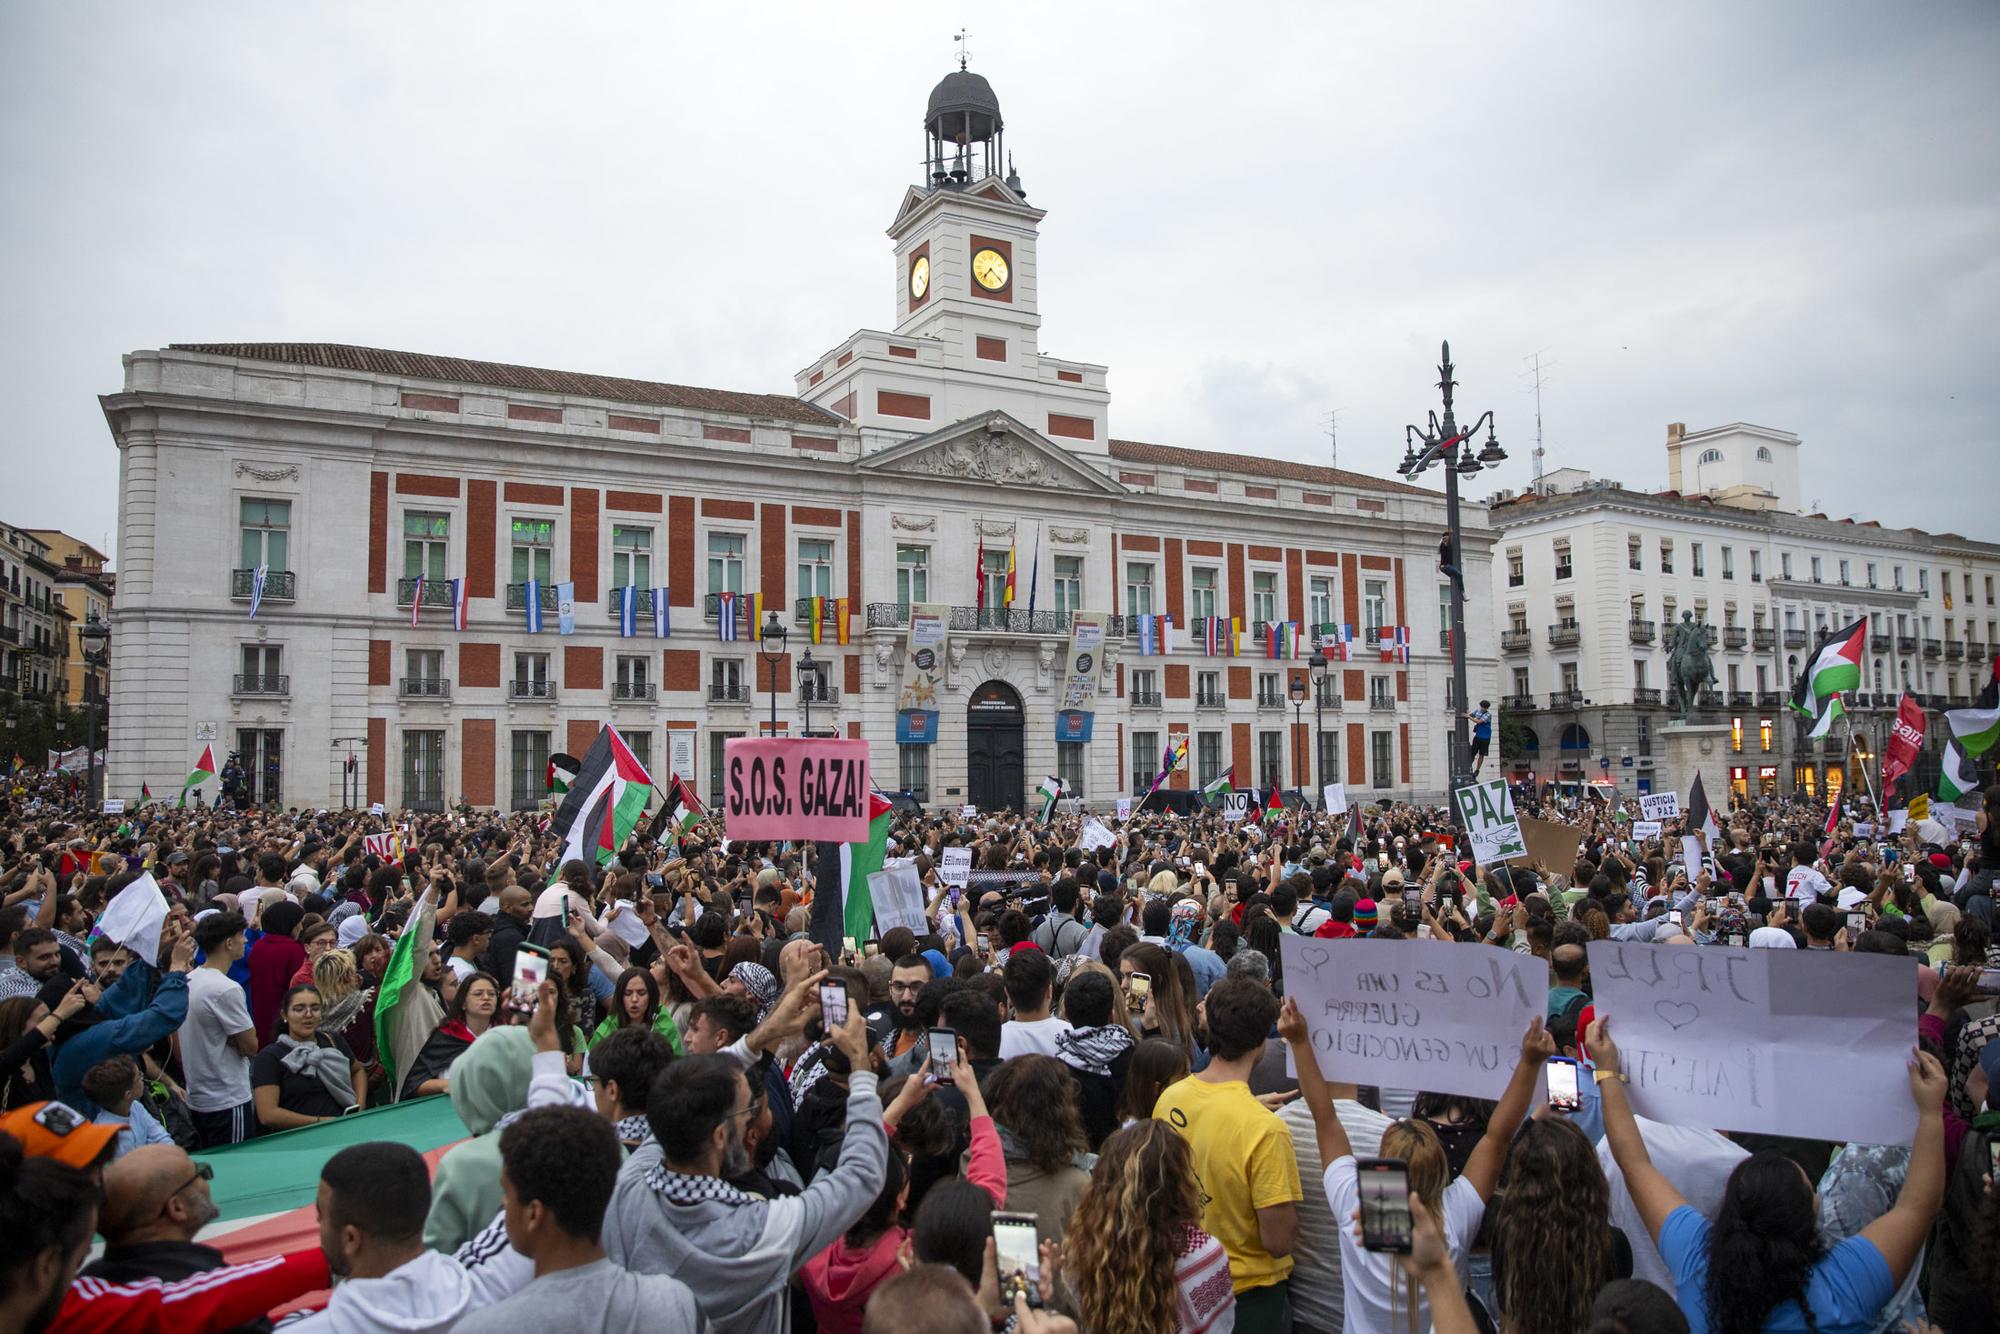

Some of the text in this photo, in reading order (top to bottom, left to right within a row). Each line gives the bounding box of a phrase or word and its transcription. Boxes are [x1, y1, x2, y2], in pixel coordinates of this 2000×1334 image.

[730, 756, 864, 818] S.O.S. GAZA!
[1225, 794, 1246, 810] NO
[1457, 779, 1517, 833] PAZ
[1643, 794, 1675, 808] JUSTICIA
[1645, 809, 1650, 818] Y
[1788, 880, 1799, 897] 7
